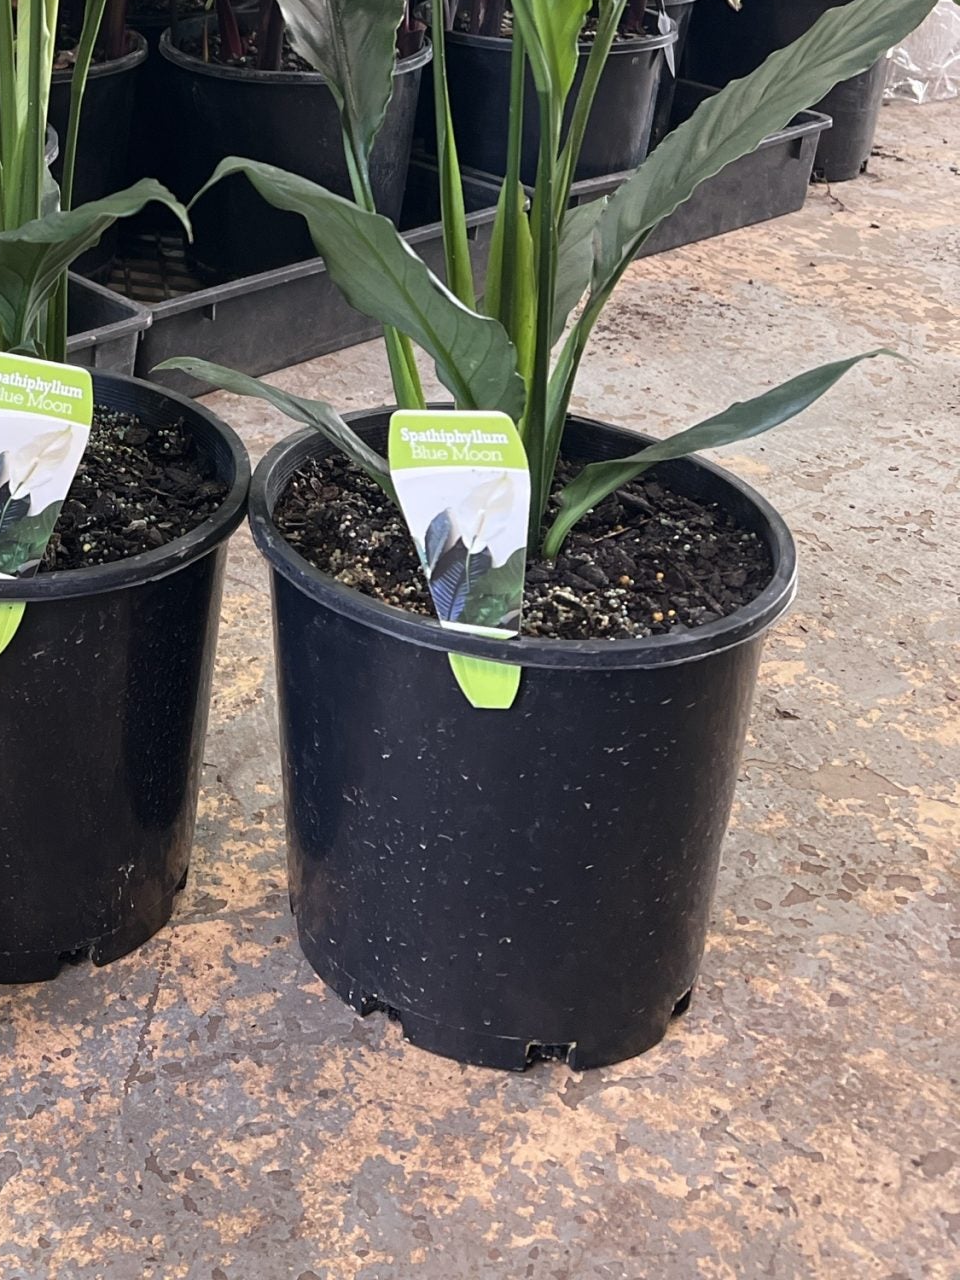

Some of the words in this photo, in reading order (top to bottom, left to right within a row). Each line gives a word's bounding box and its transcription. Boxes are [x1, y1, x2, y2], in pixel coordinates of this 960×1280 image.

[27, 391, 73, 415] Moon
[400, 426, 509, 448] Spathiphyllum
[410, 443, 448, 460] Blue
[452, 445, 503, 461] Moon
